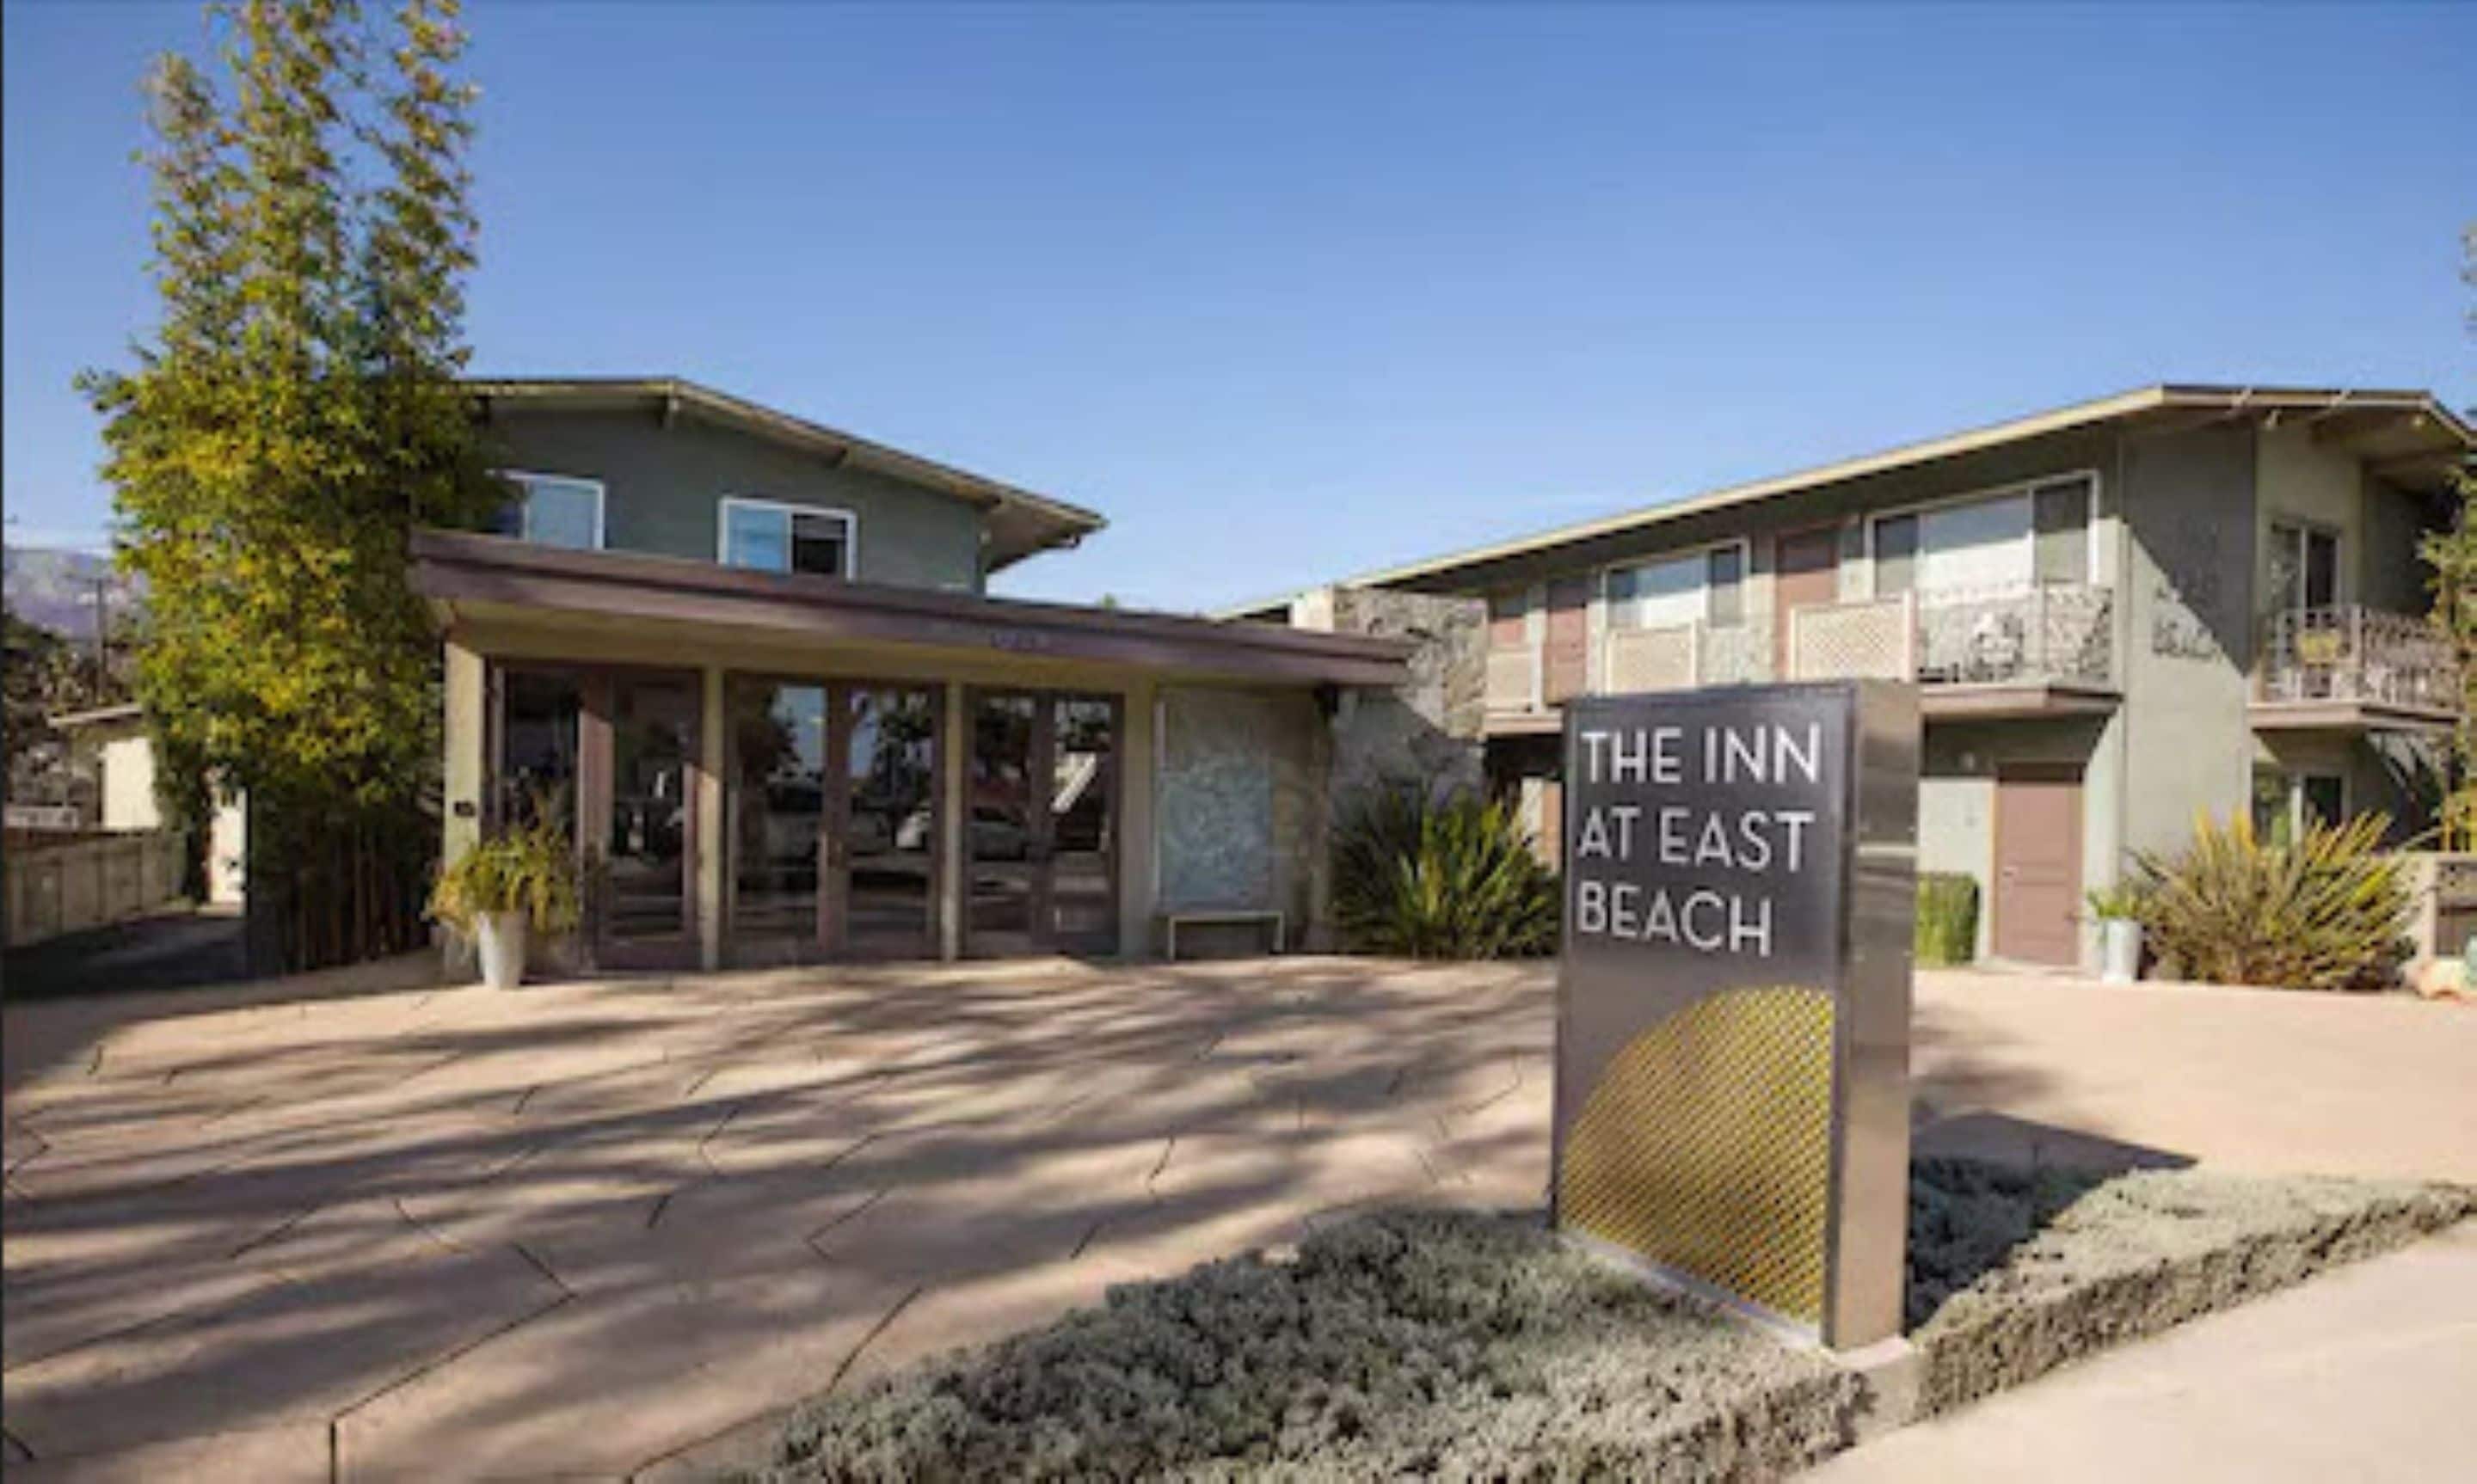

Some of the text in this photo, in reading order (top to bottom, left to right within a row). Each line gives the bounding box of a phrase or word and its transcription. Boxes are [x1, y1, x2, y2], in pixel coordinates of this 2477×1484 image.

[1580, 721, 1822, 784] THE INN
[1577, 806, 1816, 872] AT EAST
[1577, 880, 1773, 957] BEACH
